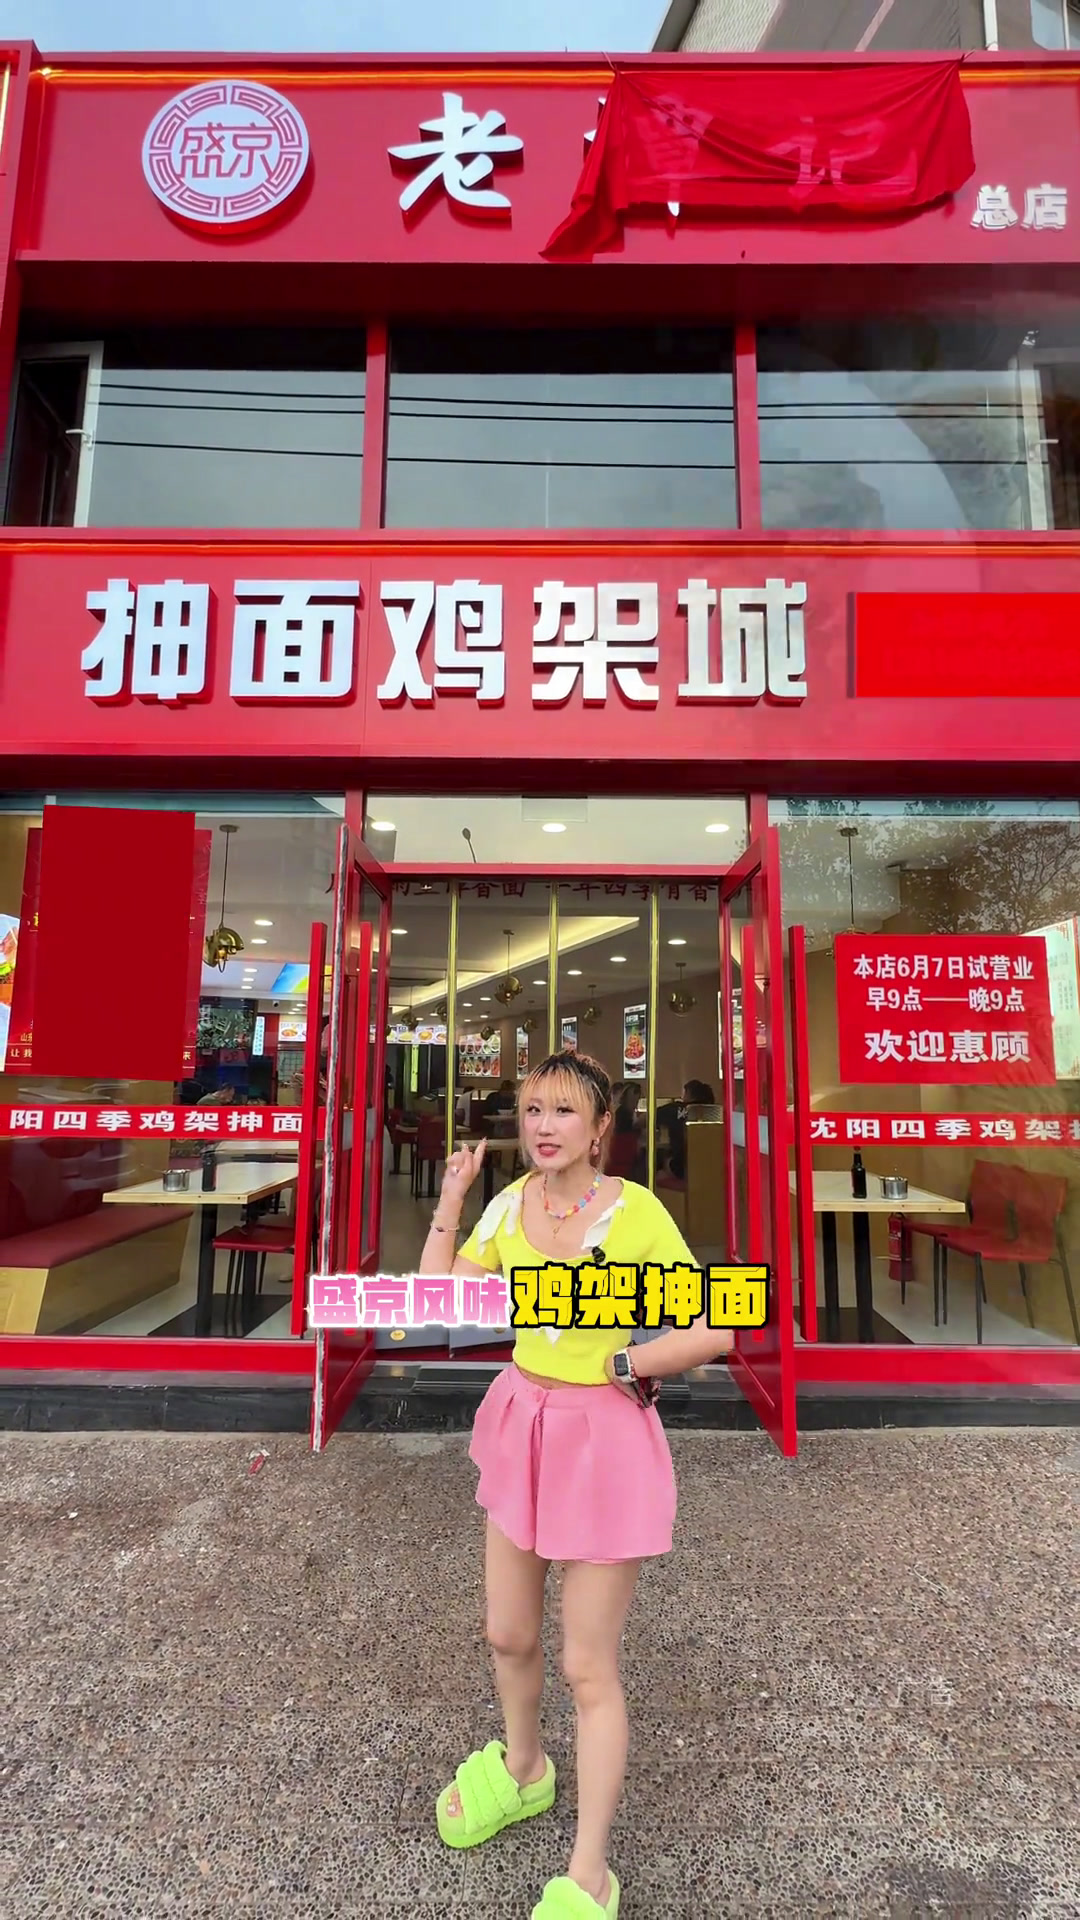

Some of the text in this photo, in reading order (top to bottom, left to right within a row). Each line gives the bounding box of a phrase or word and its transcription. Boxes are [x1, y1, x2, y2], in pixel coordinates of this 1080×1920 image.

[178, 122, 278, 179] 盛京
[971, 183, 1067, 230] 总店
[853, 954, 1035, 980] 本店6月7日试营业
[864, 1029, 1032, 1064] 欢迎惠顾
